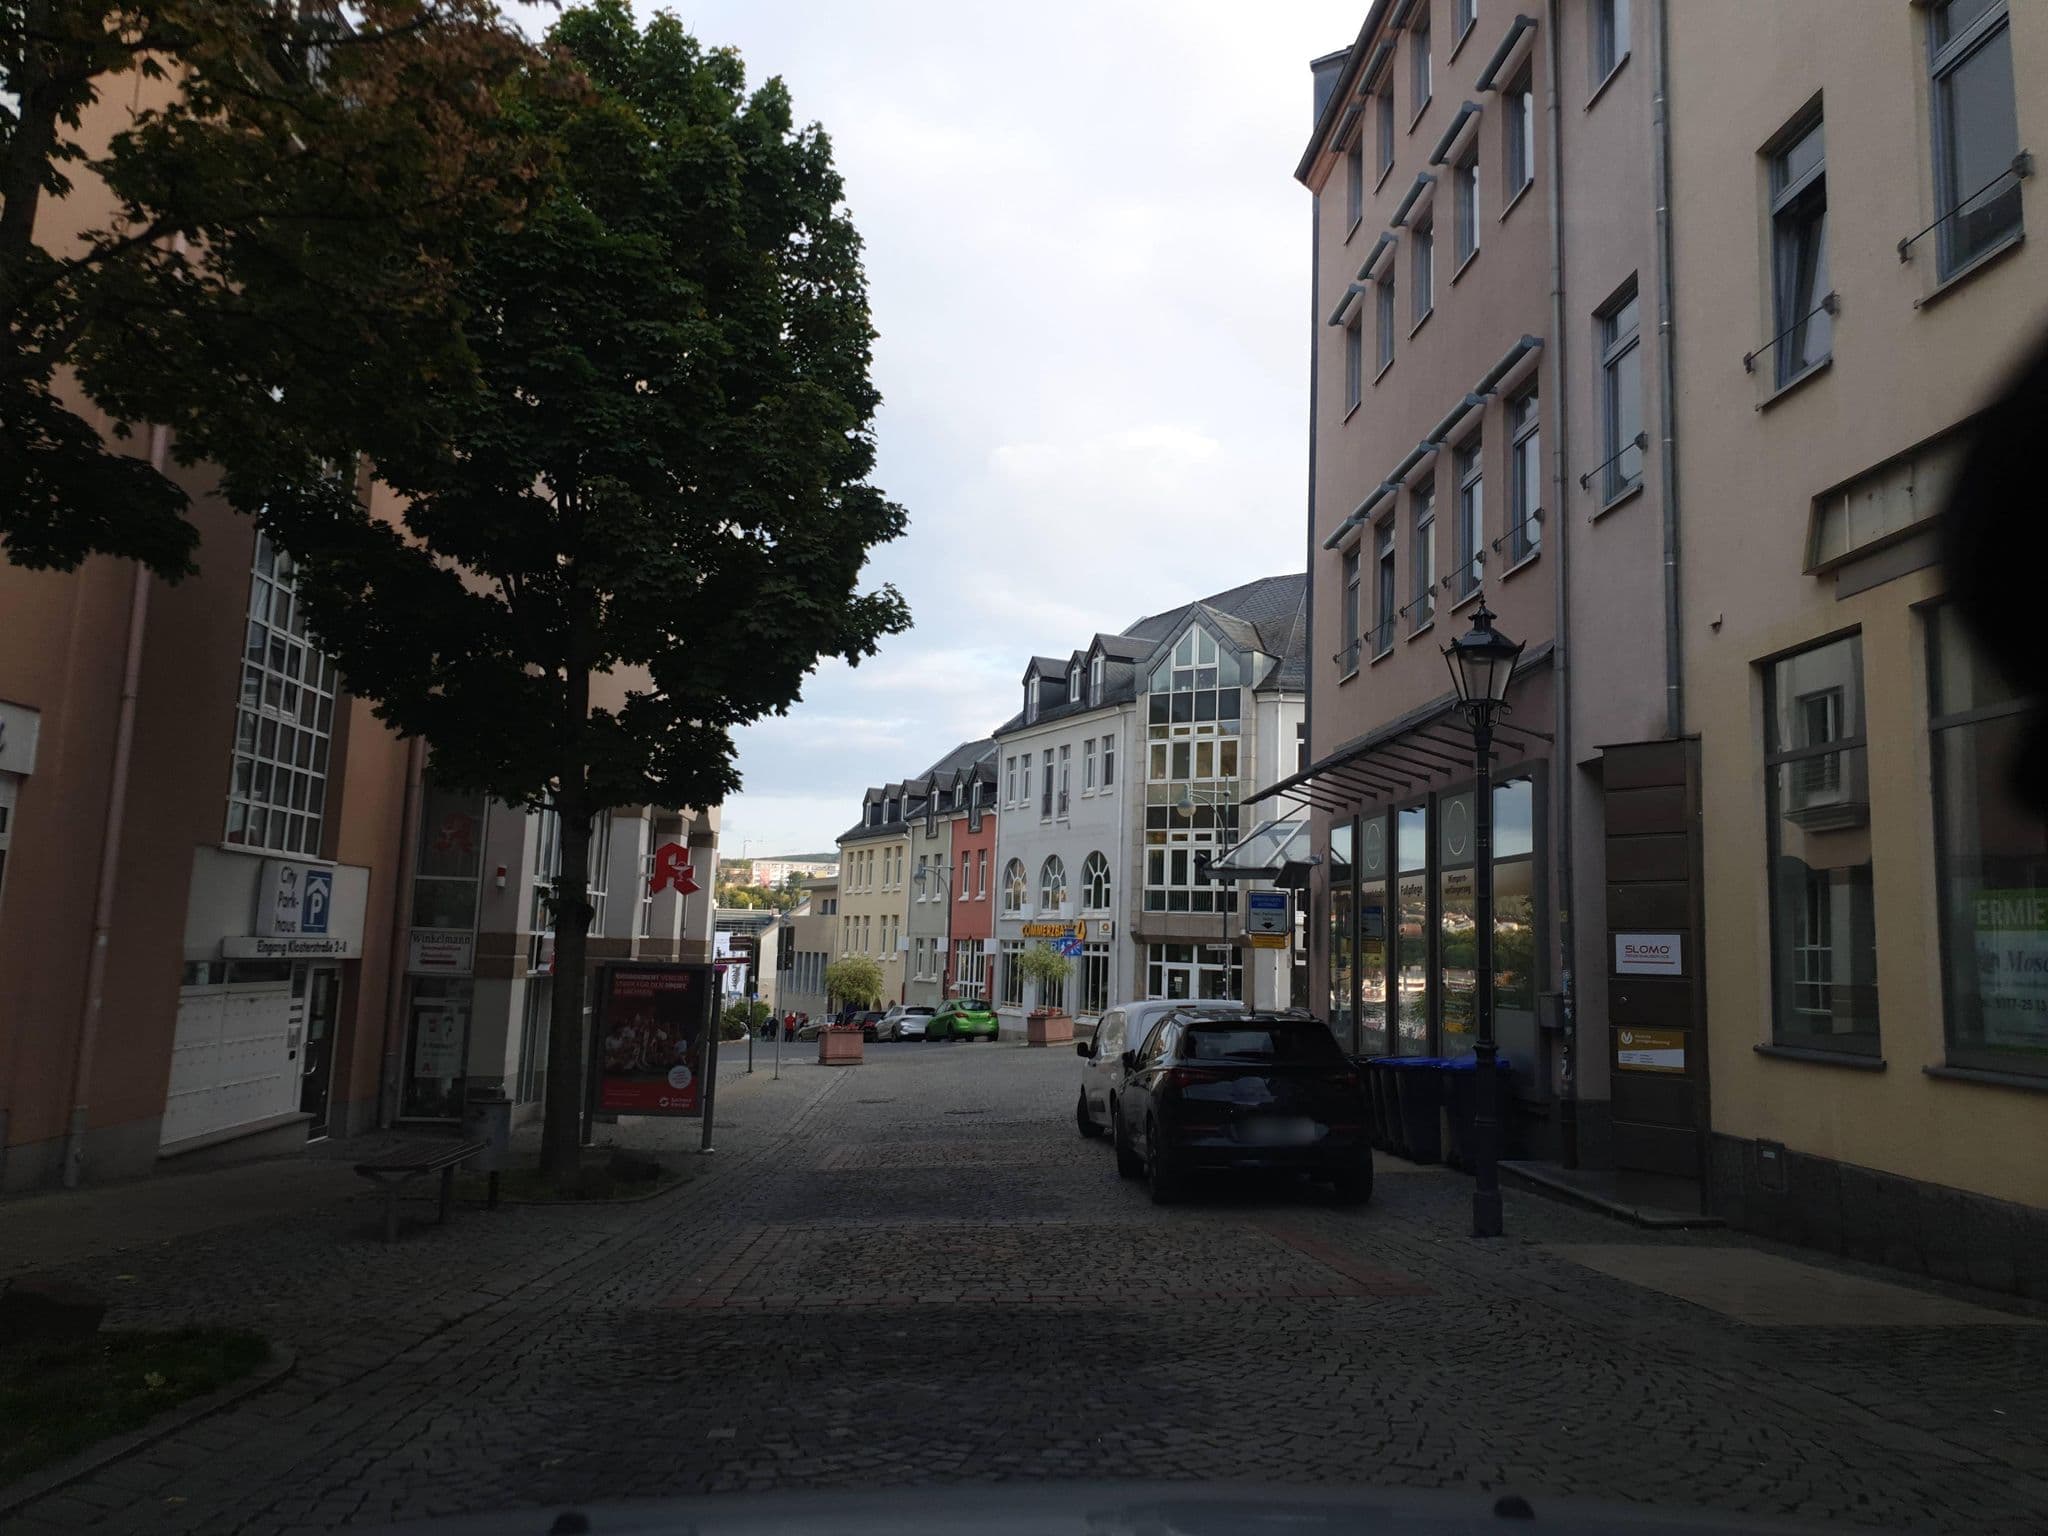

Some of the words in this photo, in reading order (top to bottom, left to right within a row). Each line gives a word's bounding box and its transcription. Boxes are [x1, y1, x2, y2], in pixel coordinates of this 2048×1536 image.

[281, 866, 297, 889] City
[278, 890, 299, 908] Park-
[414, 934, 471, 945] Winkelmann
[257, 940, 287, 956] Eingang
[1625, 944, 1669, 954] SLOMO
